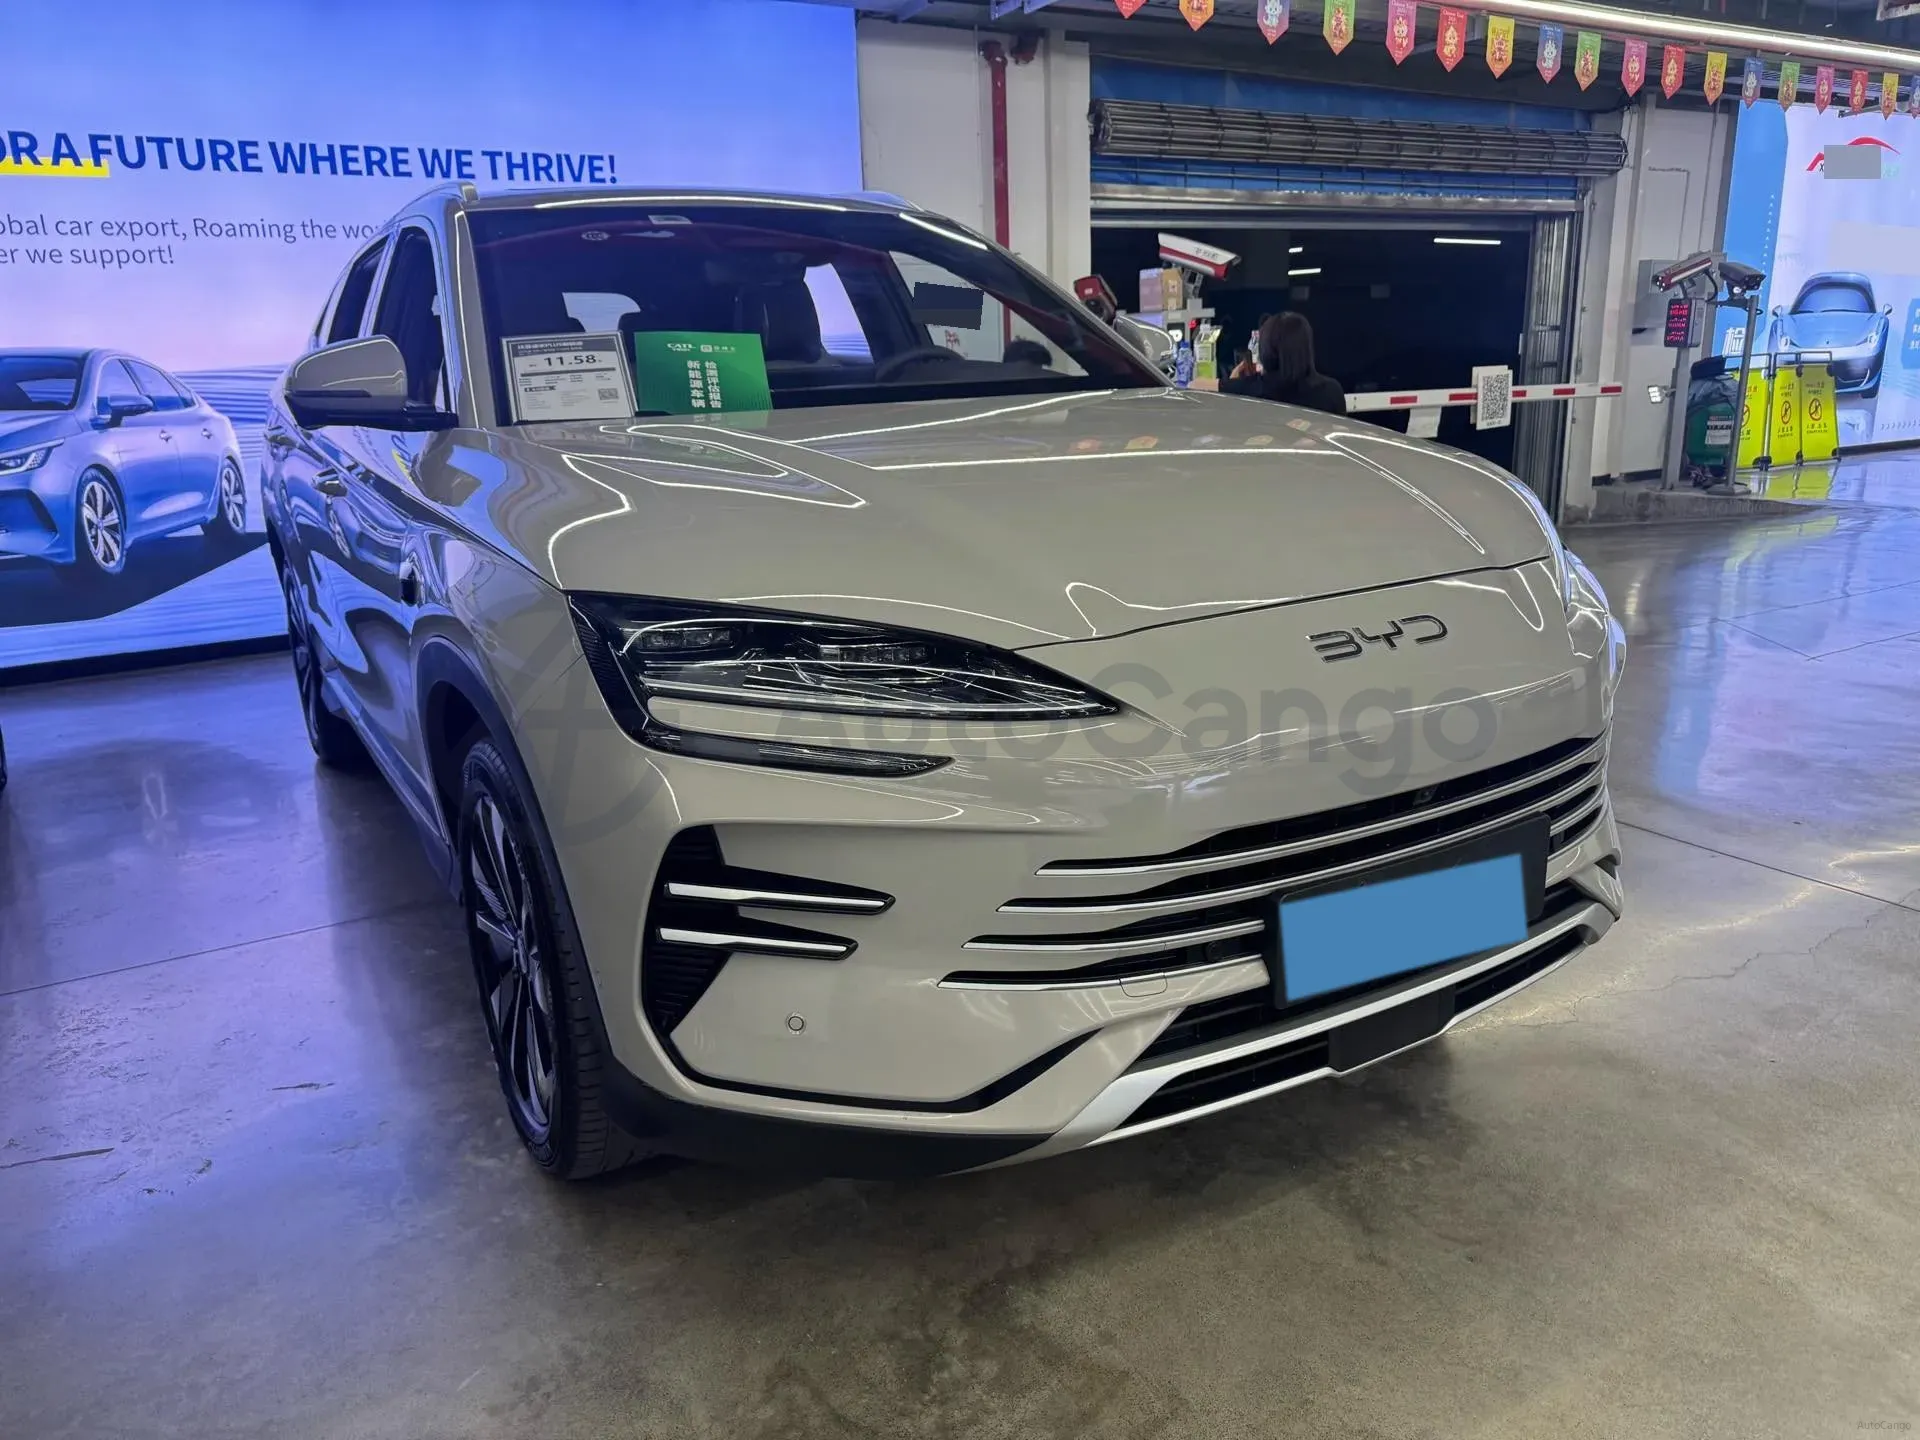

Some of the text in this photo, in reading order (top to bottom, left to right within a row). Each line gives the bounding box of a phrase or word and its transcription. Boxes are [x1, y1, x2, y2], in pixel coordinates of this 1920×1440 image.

[0, 129, 618, 184] R A FUTURE WHERE WE THRIVE!
[54, 219, 94, 237] car
[100, 218, 188, 242] export,
[193, 217, 297, 245] Roaming
[300, 218, 337, 240] the
[342, 223, 380, 240] wo
[25, 248, 63, 265] we
[70, 245, 175, 270] support!
[544, 354, 597, 367] 11.58
[687, 360, 705, 408] 新能源车辆
[1305, 614, 1449, 663] BYD
